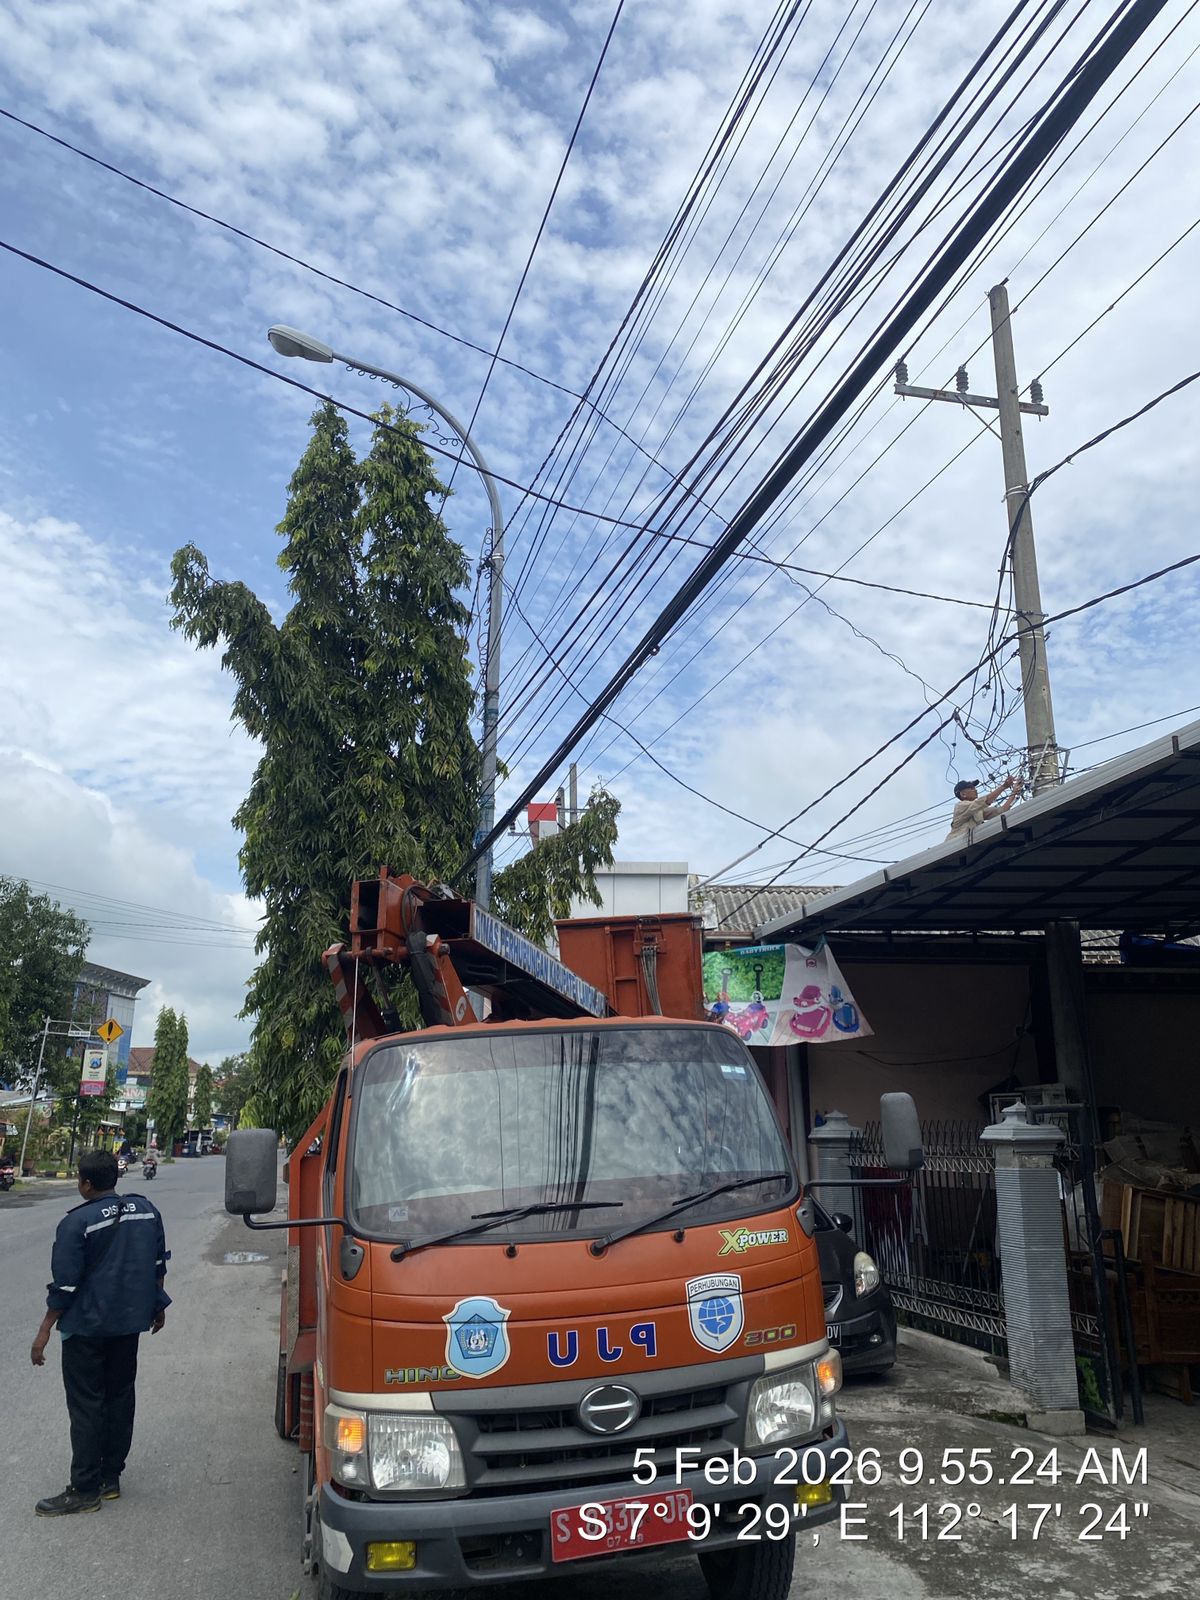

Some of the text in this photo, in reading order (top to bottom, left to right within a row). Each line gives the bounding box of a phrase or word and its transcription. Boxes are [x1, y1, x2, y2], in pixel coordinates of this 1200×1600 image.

[475, 909, 499, 953] DINAS
[501, 927, 549, 985] PERHUBUNGAN
[101, 1203, 137, 1217] DISUB
[689, 1278, 738, 1295] PERHUBUNGAN
[744, 1324, 796, 1347] 300
[826, 1325, 839, 1339] DV
[556, 1512, 571, 1543] S
[662, 1493, 689, 1524] JP
